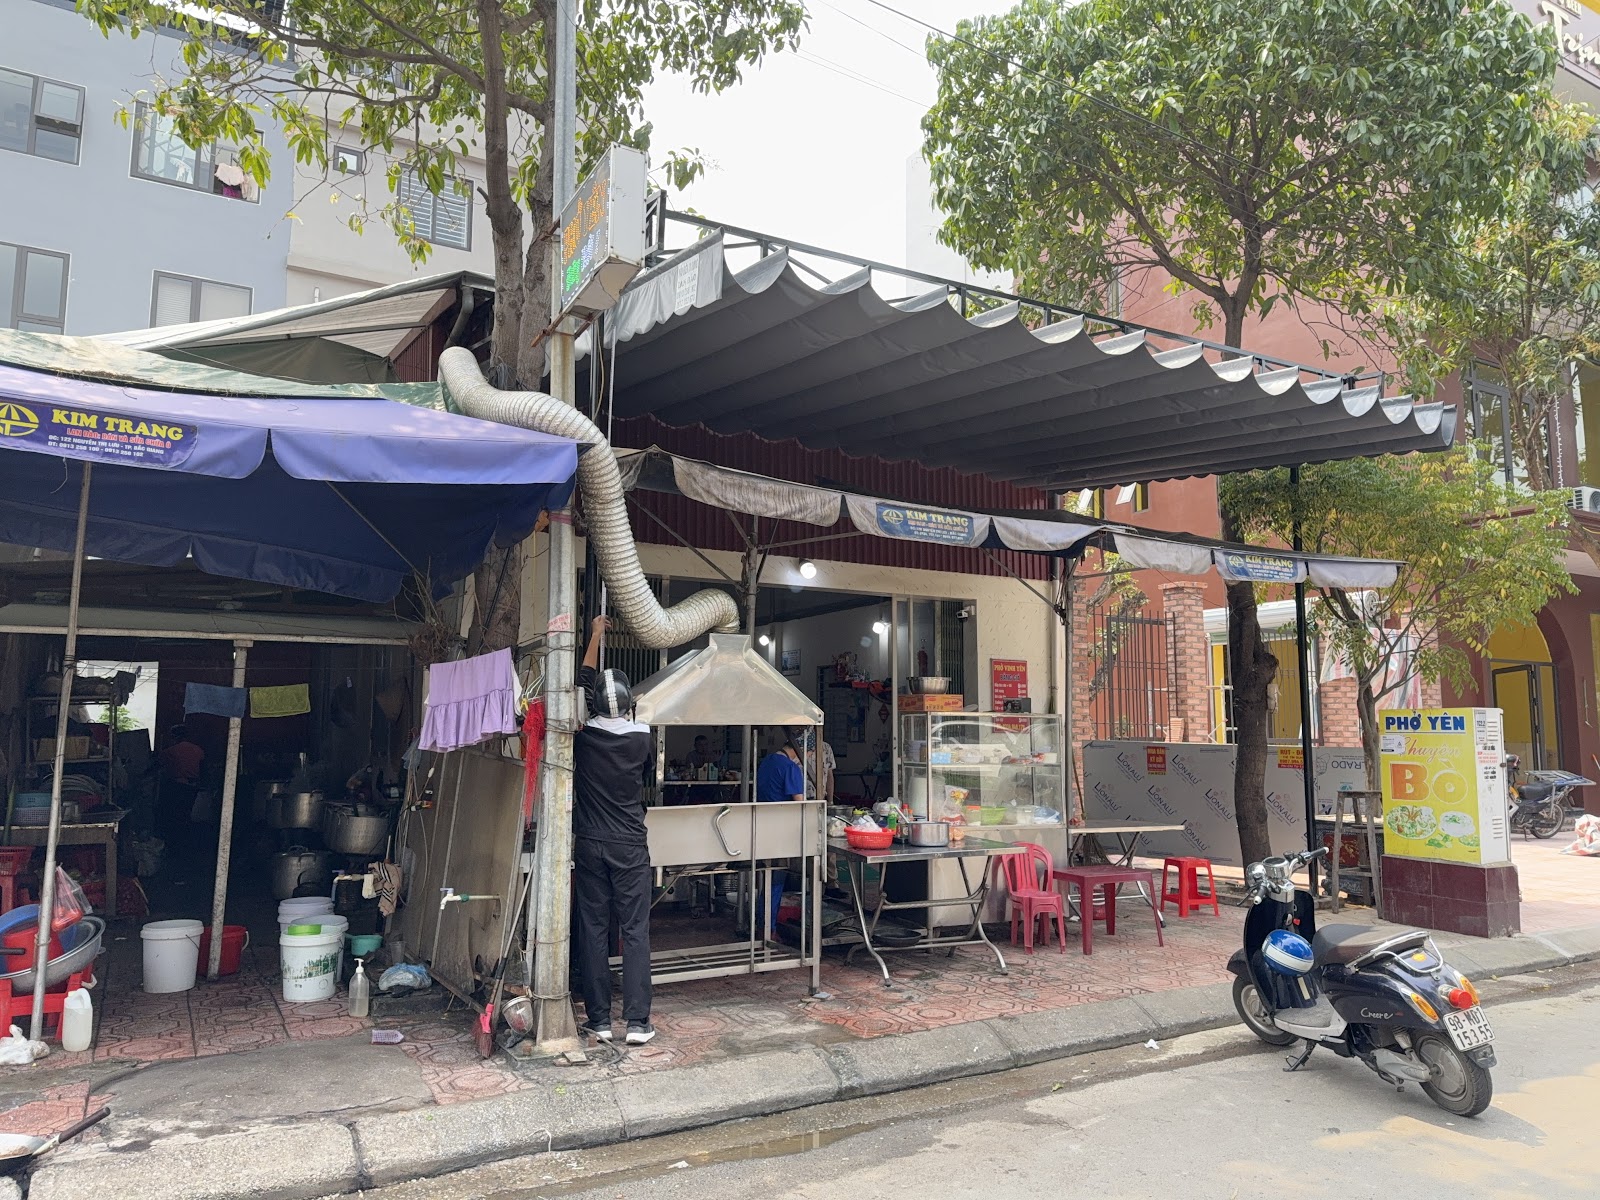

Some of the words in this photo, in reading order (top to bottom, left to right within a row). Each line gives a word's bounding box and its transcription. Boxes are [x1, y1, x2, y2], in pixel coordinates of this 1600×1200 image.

[52, 409, 98, 429] KIM
[103, 416, 184, 441] TRANG
[146, 447, 165, 455] GIANG
[905, 509, 928, 521] KIM
[929, 513, 969, 527] TRANG
[1245, 555, 1262, 564] KIM
[1263, 557, 1293, 568] TRANG
[1016, 664, 1026, 672] YÊN
[1385, 711, 1422, 731] PHỞ
[1427, 711, 1466, 731] YÊN
[1389, 758, 1469, 805] BÒ
[1456, 1023, 1494, 1048] 153.55
